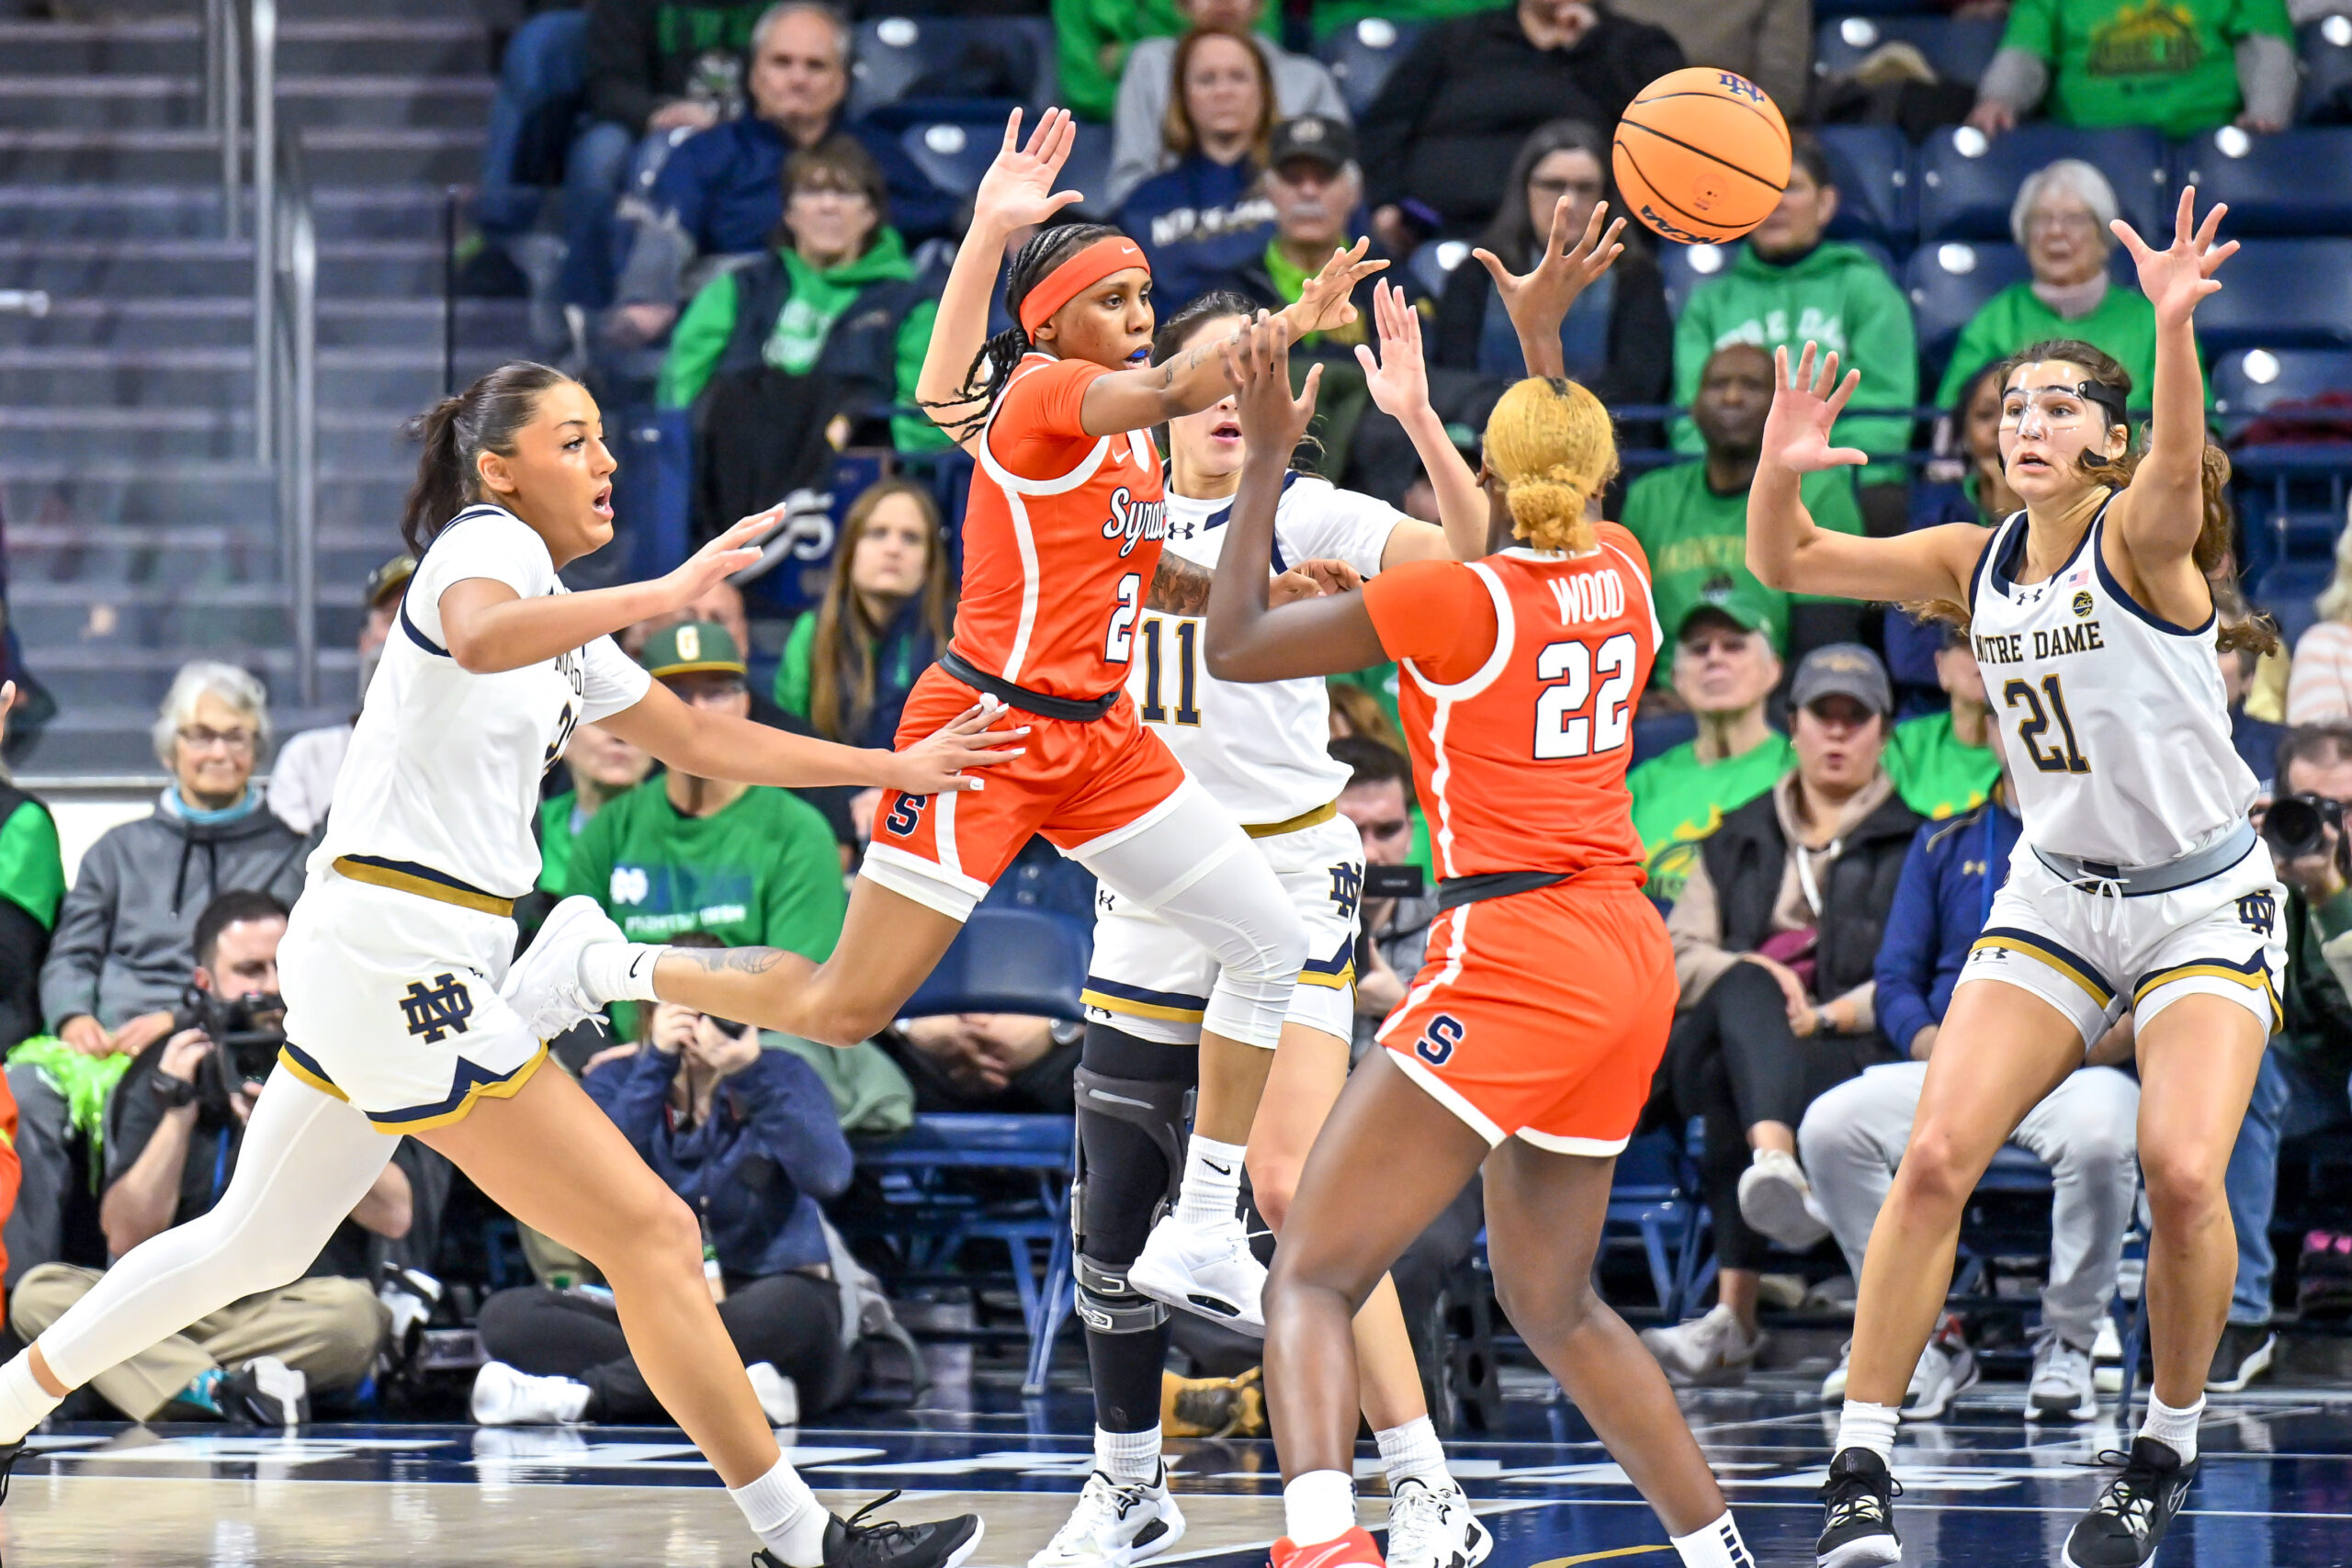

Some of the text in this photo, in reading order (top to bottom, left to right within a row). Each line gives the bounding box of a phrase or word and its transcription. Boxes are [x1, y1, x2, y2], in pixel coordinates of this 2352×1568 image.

[1104, 572, 1141, 664] 2
[1547, 569, 1625, 626] WOOD
[1140, 616, 1202, 728] 11
[2032, 620, 2104, 660] DAME
[1532, 631, 1637, 761] 22
[2003, 672, 2092, 774] 21
[885, 792, 928, 838] S
[1413, 1012, 1465, 1067] S
